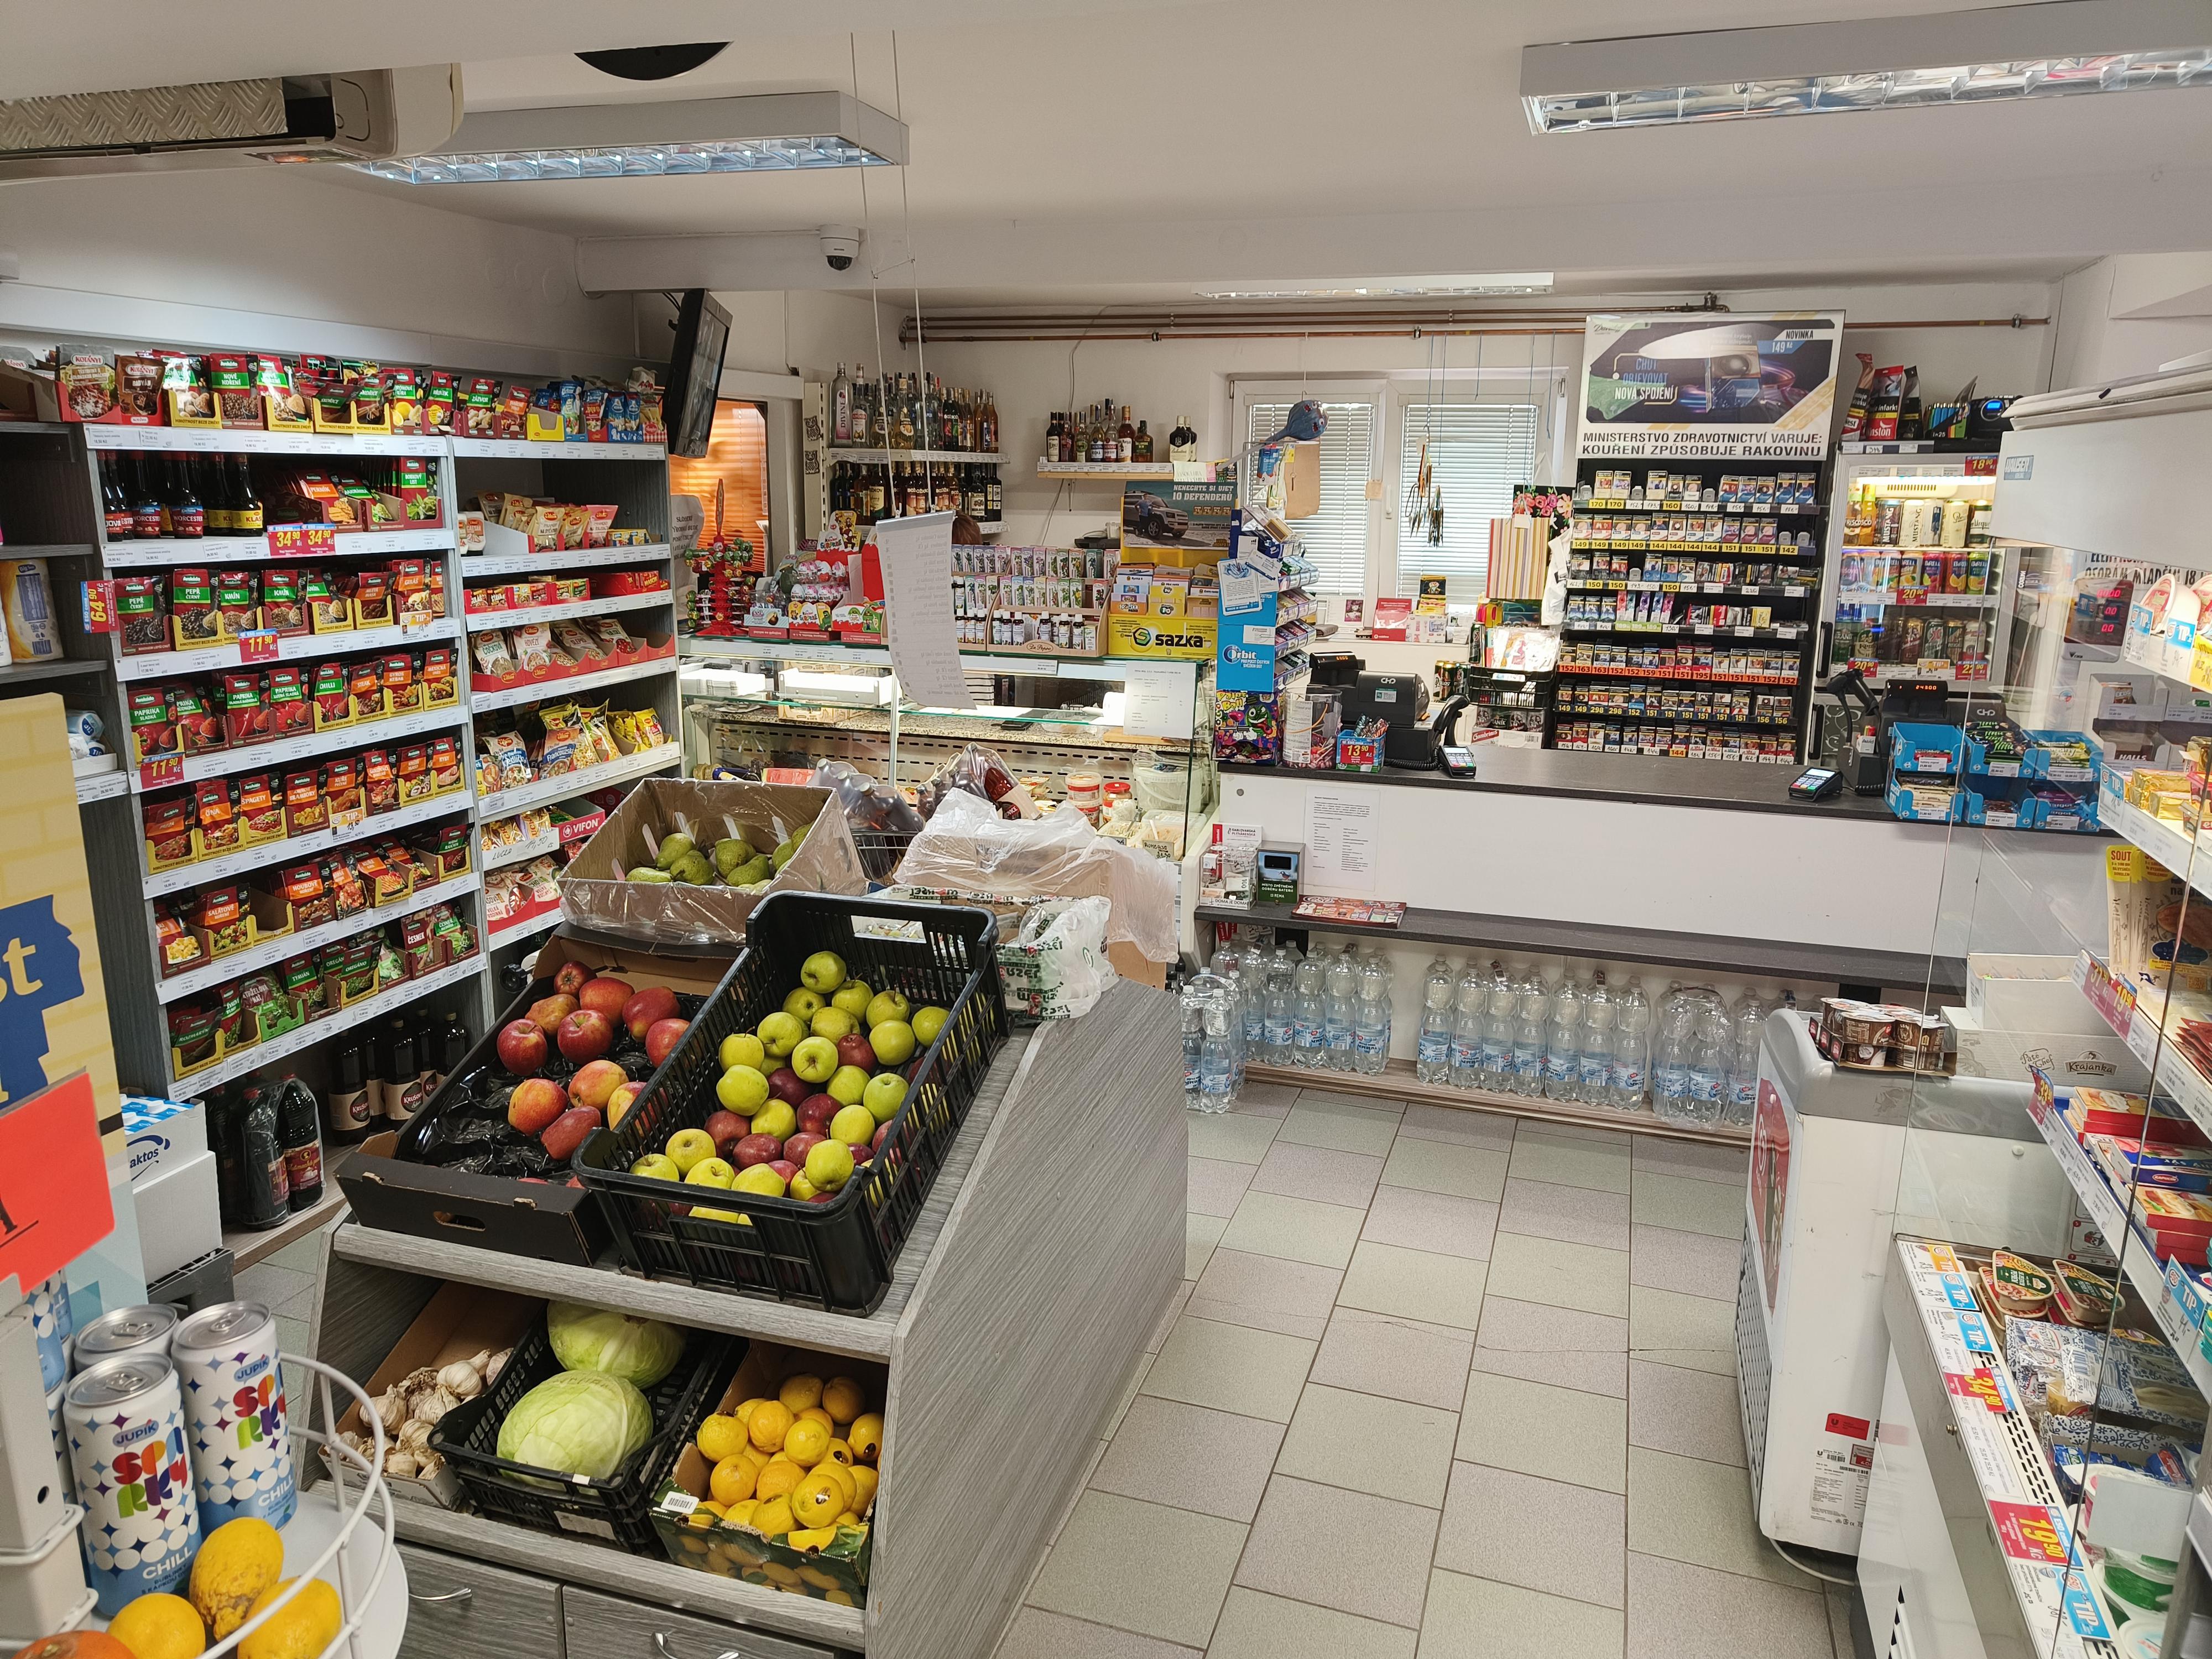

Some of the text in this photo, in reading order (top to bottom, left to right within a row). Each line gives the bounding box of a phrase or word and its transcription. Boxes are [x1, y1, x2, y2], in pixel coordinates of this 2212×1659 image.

[1786, 330, 1813, 339] NOVINKA
[1772, 342, 1786, 353] 149
[75, 354, 102, 364] KOTÁNYI
[1615, 385, 1674, 400] NOVÁ SPOJENÍ
[1584, 432, 1822, 444] MINISTERSTVO ZDRAVOTNICTVÍ VARUJE:
[1582, 444, 1820, 457] KOUŘENÍ ZPŮSOBUJE RAKOVINU
[1972, 460, 1985, 469] 18
[2005, 456, 2029, 473] HAUSER
[1185, 491, 1233, 501] DEFENDERŮ
[1882, 507, 1895, 543] MUSTANG
[1913, 508, 1922, 542] MUSTANG
[276, 531, 300, 547] 34 90
[307, 530, 322, 545] 34
[2185, 568, 2196, 585] 18
[185, 587, 200, 595] PEPŘ
[224, 591, 241, 600] KMÍN
[1902, 589, 1915, 598] 20
[88, 582, 107, 623] 64 90 Kč
[2140, 612, 2150, 627] TIP
[2178, 624, 2189, 641] TIP
[248, 637, 263, 653] 11
[264, 635, 273, 644] 90
[1155, 633, 1203, 648] sazka
[482, 643, 503, 656] ČOČKOVÁ
[1223, 644, 1256, 664] Orbit
[1854, 661, 1867, 670] 20
[134, 707, 160, 716] PAPRIKA
[1222, 698, 1243, 711] Ball
[1472, 730, 1499, 742] Gambrinus
[1347, 745, 1361, 757] 13
[151, 760, 166, 777] 11
[168, 758, 178, 766] 90
[2111, 775, 2121, 791] TIP
[241, 794, 267, 805] ŠPAGETY
[289, 790, 316, 801] BRAMBORY
[205, 808, 220, 817] ČÍNA
[346, 811, 358, 820] TIP
[573, 818, 599, 833] VIFON
[2111, 850, 2132, 861] SOUT
[292, 880, 318, 891] HOUBOVÉ
[207, 904, 235, 917] SALÁTOVÉ
[408, 931, 425, 945] ČESNEK
[345, 960, 367, 972] OREGÁNO
[291, 971, 310, 982] TYMIÁN
[179, 1028, 209, 1042] ROZMARÝN
[2068, 1061, 2112, 1074] Krajanka
[129, 1147, 159, 1168] aktos
[1939, 1259, 1955, 1272] TIP
[1950, 1288, 1970, 1303] TIP
[2182, 1286, 2198, 1311] TIP
[1967, 1329, 1986, 1345] TIP
[237, 1354, 269, 1380] JUPÍK
[1964, 1375, 2002, 1406] 34 90
[116, 1420, 158, 1445] JUPÍK
[257, 1474, 294, 1507] CHILL
[2018, 1518, 2059, 1543] 19
[2053, 1518, 2070, 1547] ESO cena
[2028, 1547, 2046, 1560] Kč
[2043, 1543, 2065, 1558] 90
[142, 1546, 193, 1580] CHILL
[2072, 1601, 2100, 1626] TIP
